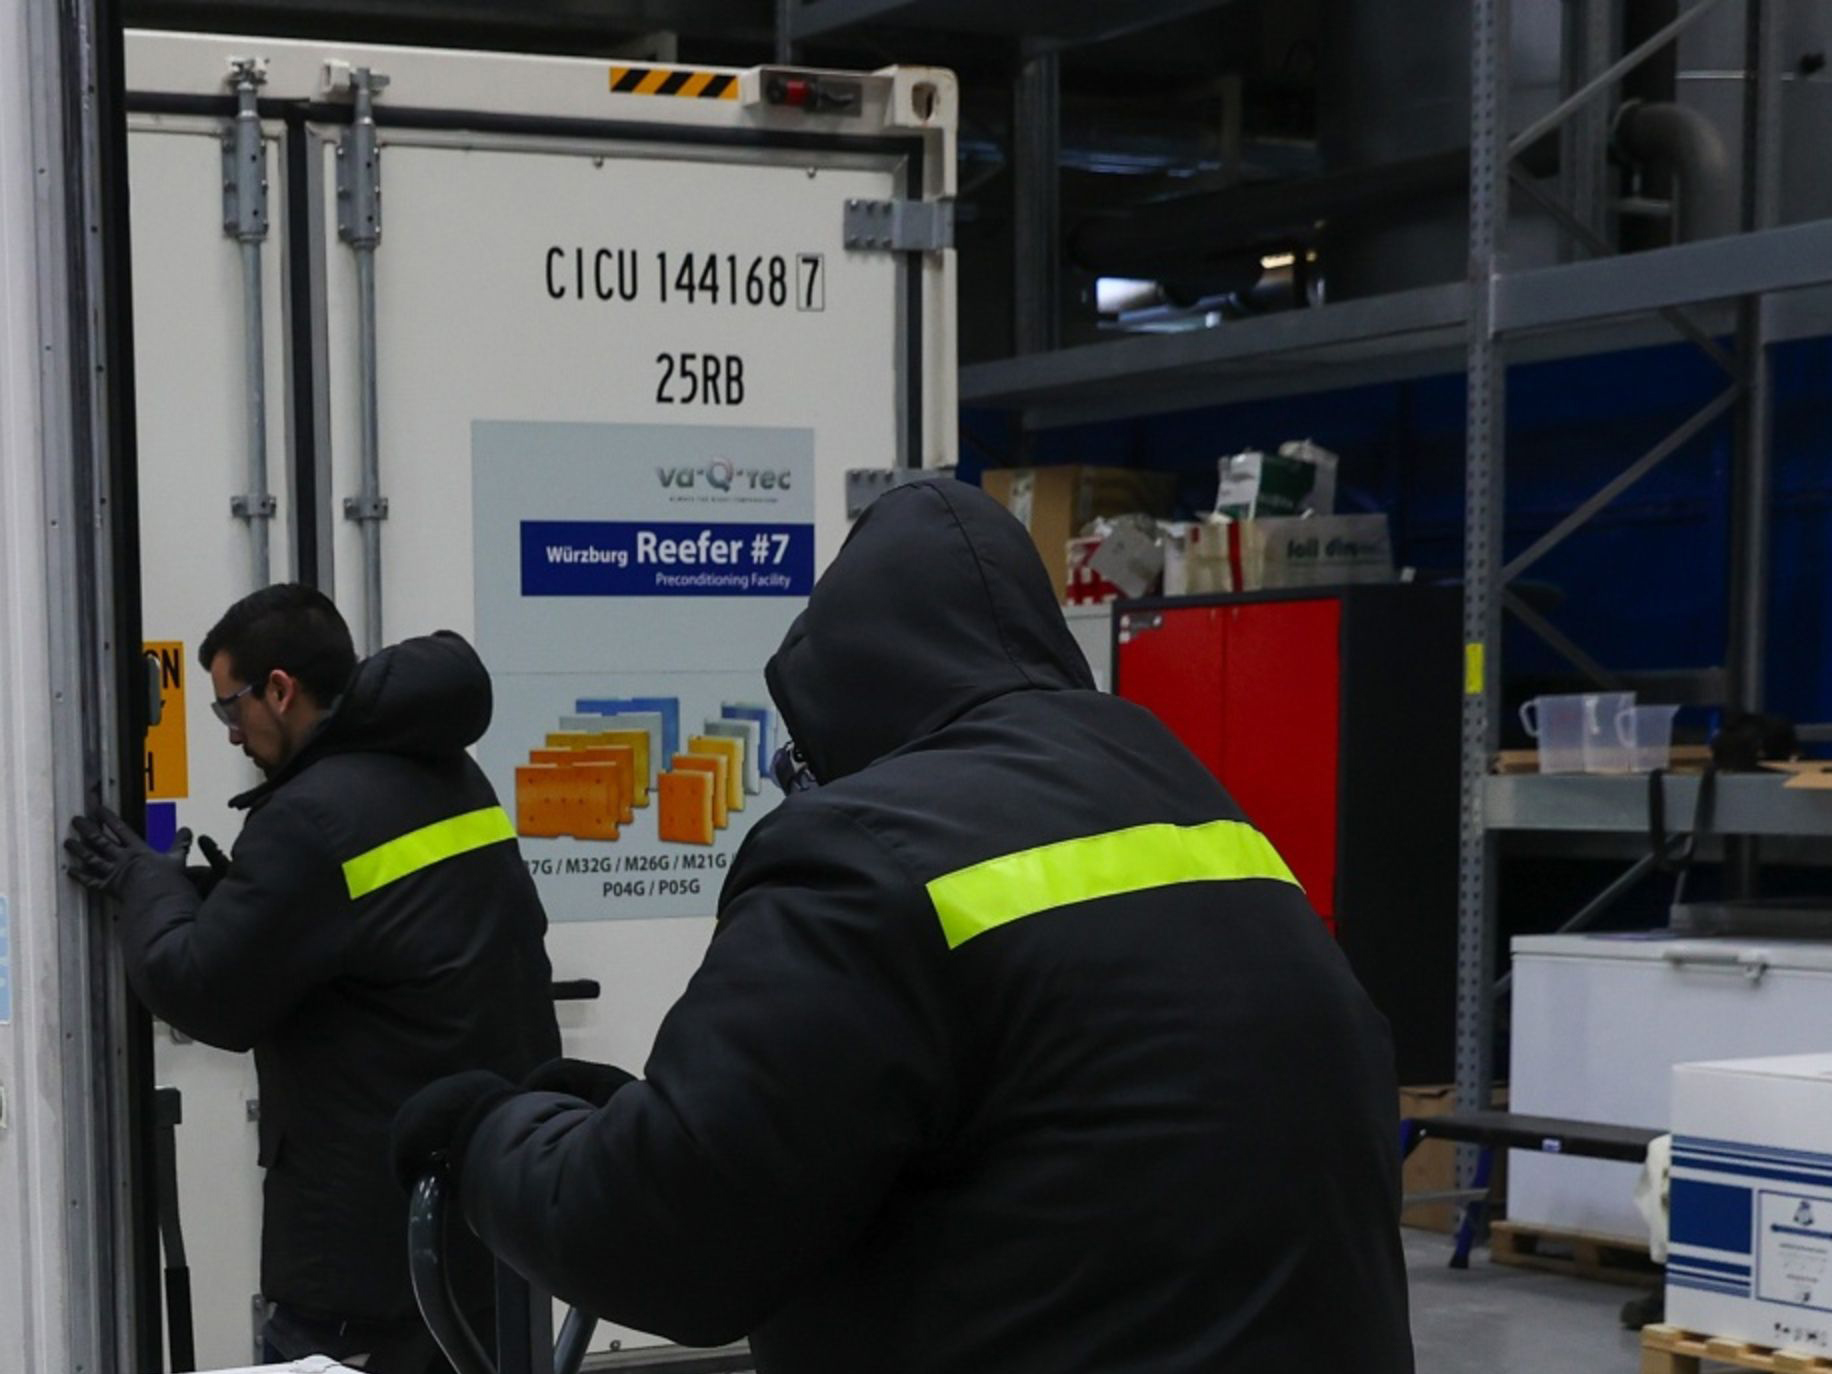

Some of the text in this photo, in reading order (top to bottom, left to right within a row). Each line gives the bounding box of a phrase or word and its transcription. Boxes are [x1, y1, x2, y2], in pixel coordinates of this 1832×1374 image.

[545, 246, 638, 301] CICU
[656, 251, 787, 307] 144168
[655, 353, 744, 405] 25RB
[545, 530, 790, 568] Würzburg Reefer #7
[656, 572, 791, 593] Preconditioning Facility
[566, 857, 611, 875] M32G
[625, 855, 669, 872] M26G
[683, 853, 727, 870] M21G
[603, 881, 645, 898] P04G
[659, 878, 701, 896] P05G
